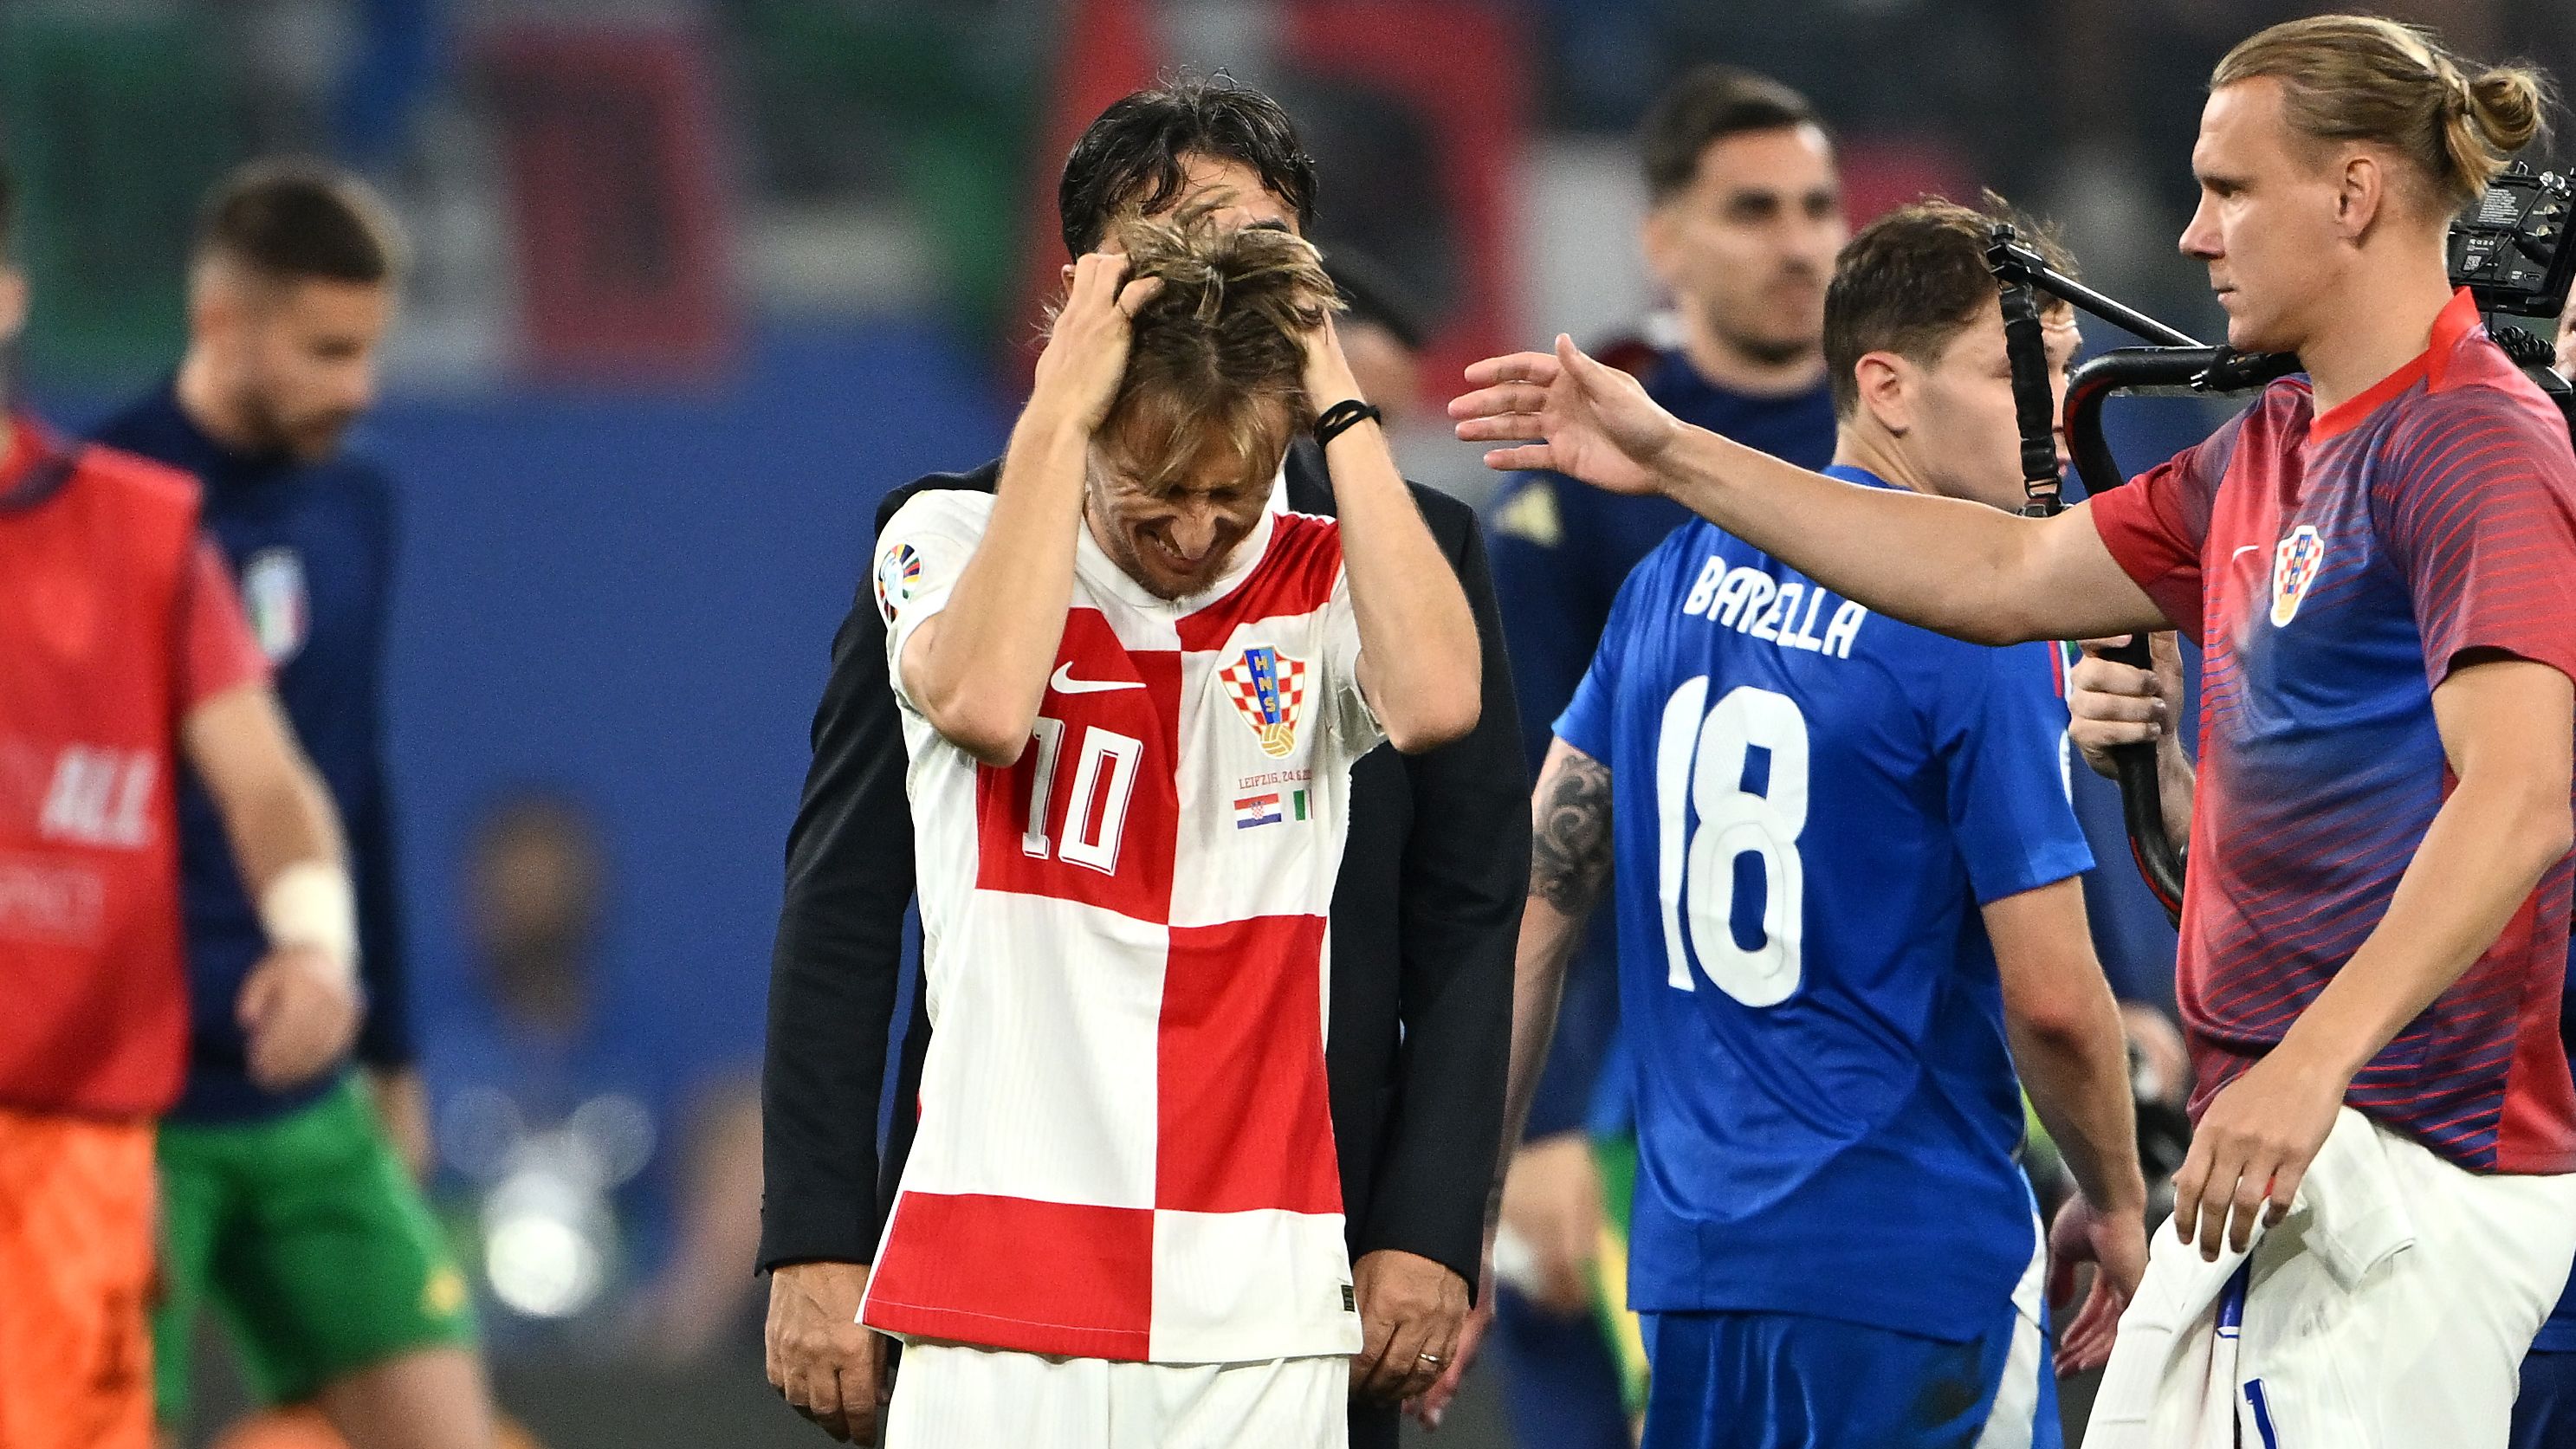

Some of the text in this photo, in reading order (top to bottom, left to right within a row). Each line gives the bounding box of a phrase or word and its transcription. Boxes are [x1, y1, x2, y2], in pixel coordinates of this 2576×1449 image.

[1683, 554, 1868, 659] BARELLA
[1254, 656, 1276, 713] HNS
[1021, 715, 1144, 877] 10
[1657, 675, 1809, 1008] 18
